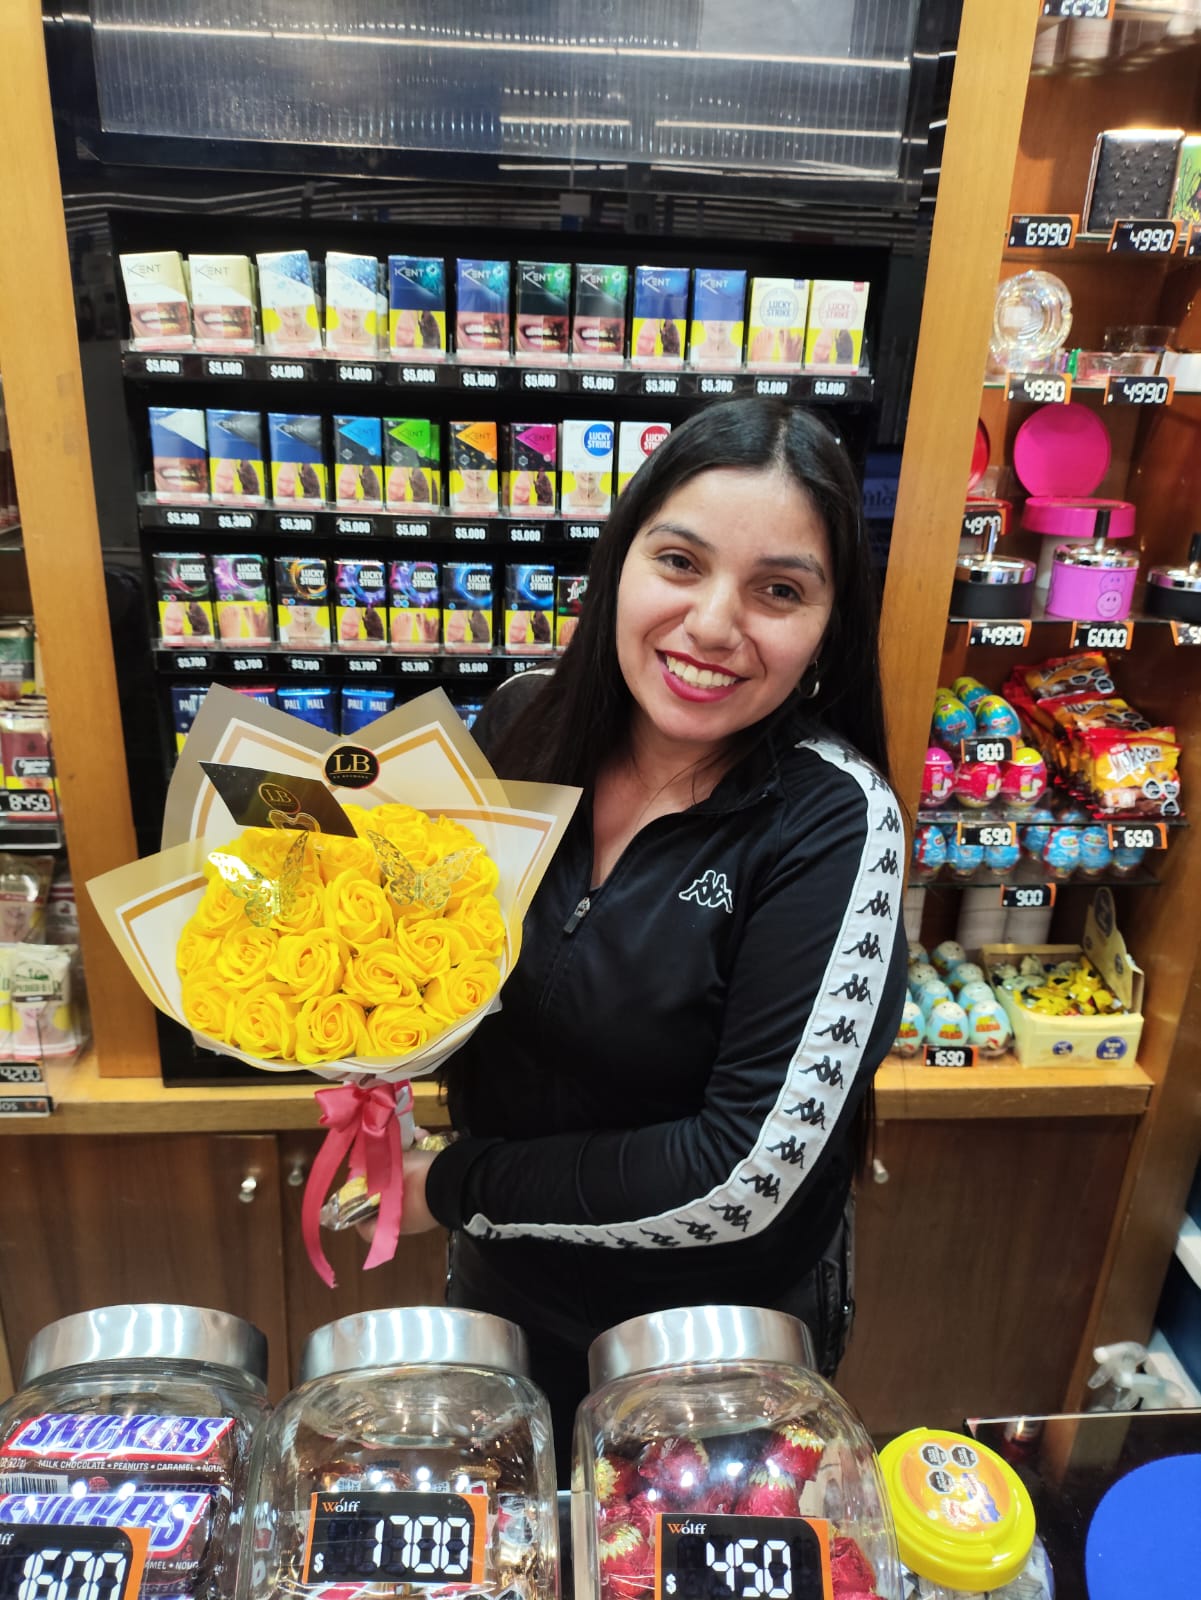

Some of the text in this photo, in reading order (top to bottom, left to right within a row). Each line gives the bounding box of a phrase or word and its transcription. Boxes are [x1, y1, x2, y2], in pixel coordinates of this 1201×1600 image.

[1026, 223, 1071, 246] 6990
[1130, 229, 1174, 251] 4990
[126, 263, 161, 279] KENT
[195, 265, 230, 280] KENT
[394, 266, 424, 282] KENT
[461, 268, 491, 284] KENT
[522, 271, 552, 287] KENT
[580, 273, 610, 289] KENT
[641, 274, 671, 292] KENT
[699, 276, 729, 294] KENT
[768, 301, 791, 309] LUCKY
[827, 303, 851, 311] LUCKY
[766, 309, 790, 317] STRIKE
[1024, 380, 1066, 402] 4990
[1123, 383, 1168, 403] 4990
[589, 432, 611, 440] LUCKY
[587, 440, 611, 449] STRIKE
[180, 565, 205, 573] LUCKY
[237, 564, 261, 572] LUCKY
[301, 570, 324, 578] LUCKY
[360, 571, 382, 579] LUCKY
[180, 573, 206, 581] STRIKE
[237, 572, 262, 580] STRIKE
[300, 578, 325, 586] STRIKE
[359, 579, 383, 587] STRIKE
[414, 572, 436, 580] LUCKY
[531, 575, 553, 583] LUCKY
[412, 580, 437, 588] STRIKE
[467, 582, 491, 590] STRIKE
[530, 583, 553, 591] STRIKE
[1087, 628, 1127, 647] 6000
[284, 698, 324, 710] PALL MALL
[347, 699, 387, 712] PALL MALL
[977, 743, 1004, 761] 800
[333, 754, 371, 772] LB
[9, 794, 51, 810] 8450
[1124, 830, 1153, 847] 650
[1016, 890, 1043, 906] 900
[20, 1414, 223, 1452] SNICKERS
[38, 1461, 59, 1469] MILK
[60, 1461, 106, 1470] CHOCOLATE
[113, 1462, 149, 1471] PEANUTS
[157, 1463, 195, 1472] CARAMEL
[314, 1515, 470, 1575] $ 1700
[666, 1539, 793, 1600] $ 450
